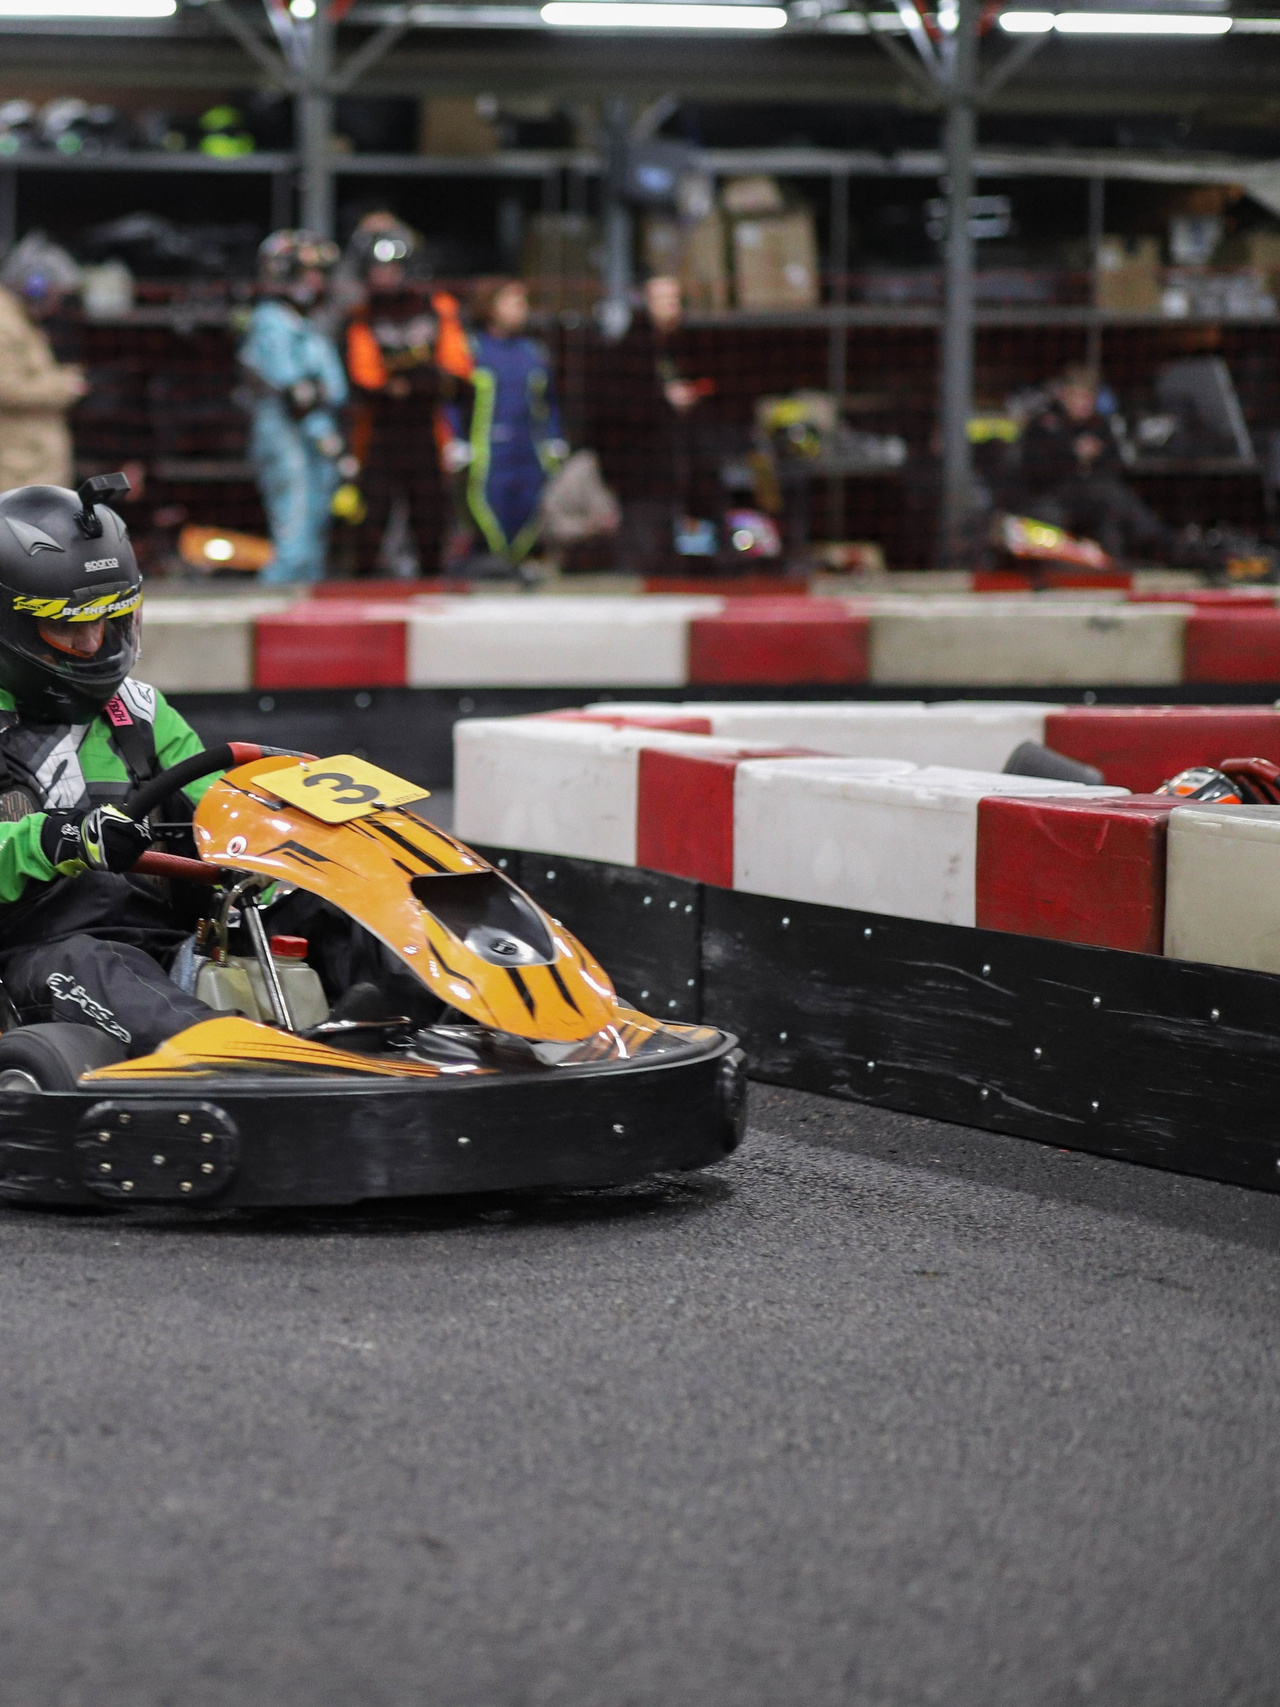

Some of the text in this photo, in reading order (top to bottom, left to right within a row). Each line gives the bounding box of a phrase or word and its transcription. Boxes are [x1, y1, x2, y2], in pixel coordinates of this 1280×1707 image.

[84, 557, 118, 572] sparco
[61, 606, 81, 616] BE
[83, 605, 107, 615] THE
[303, 772, 380, 805] 3
